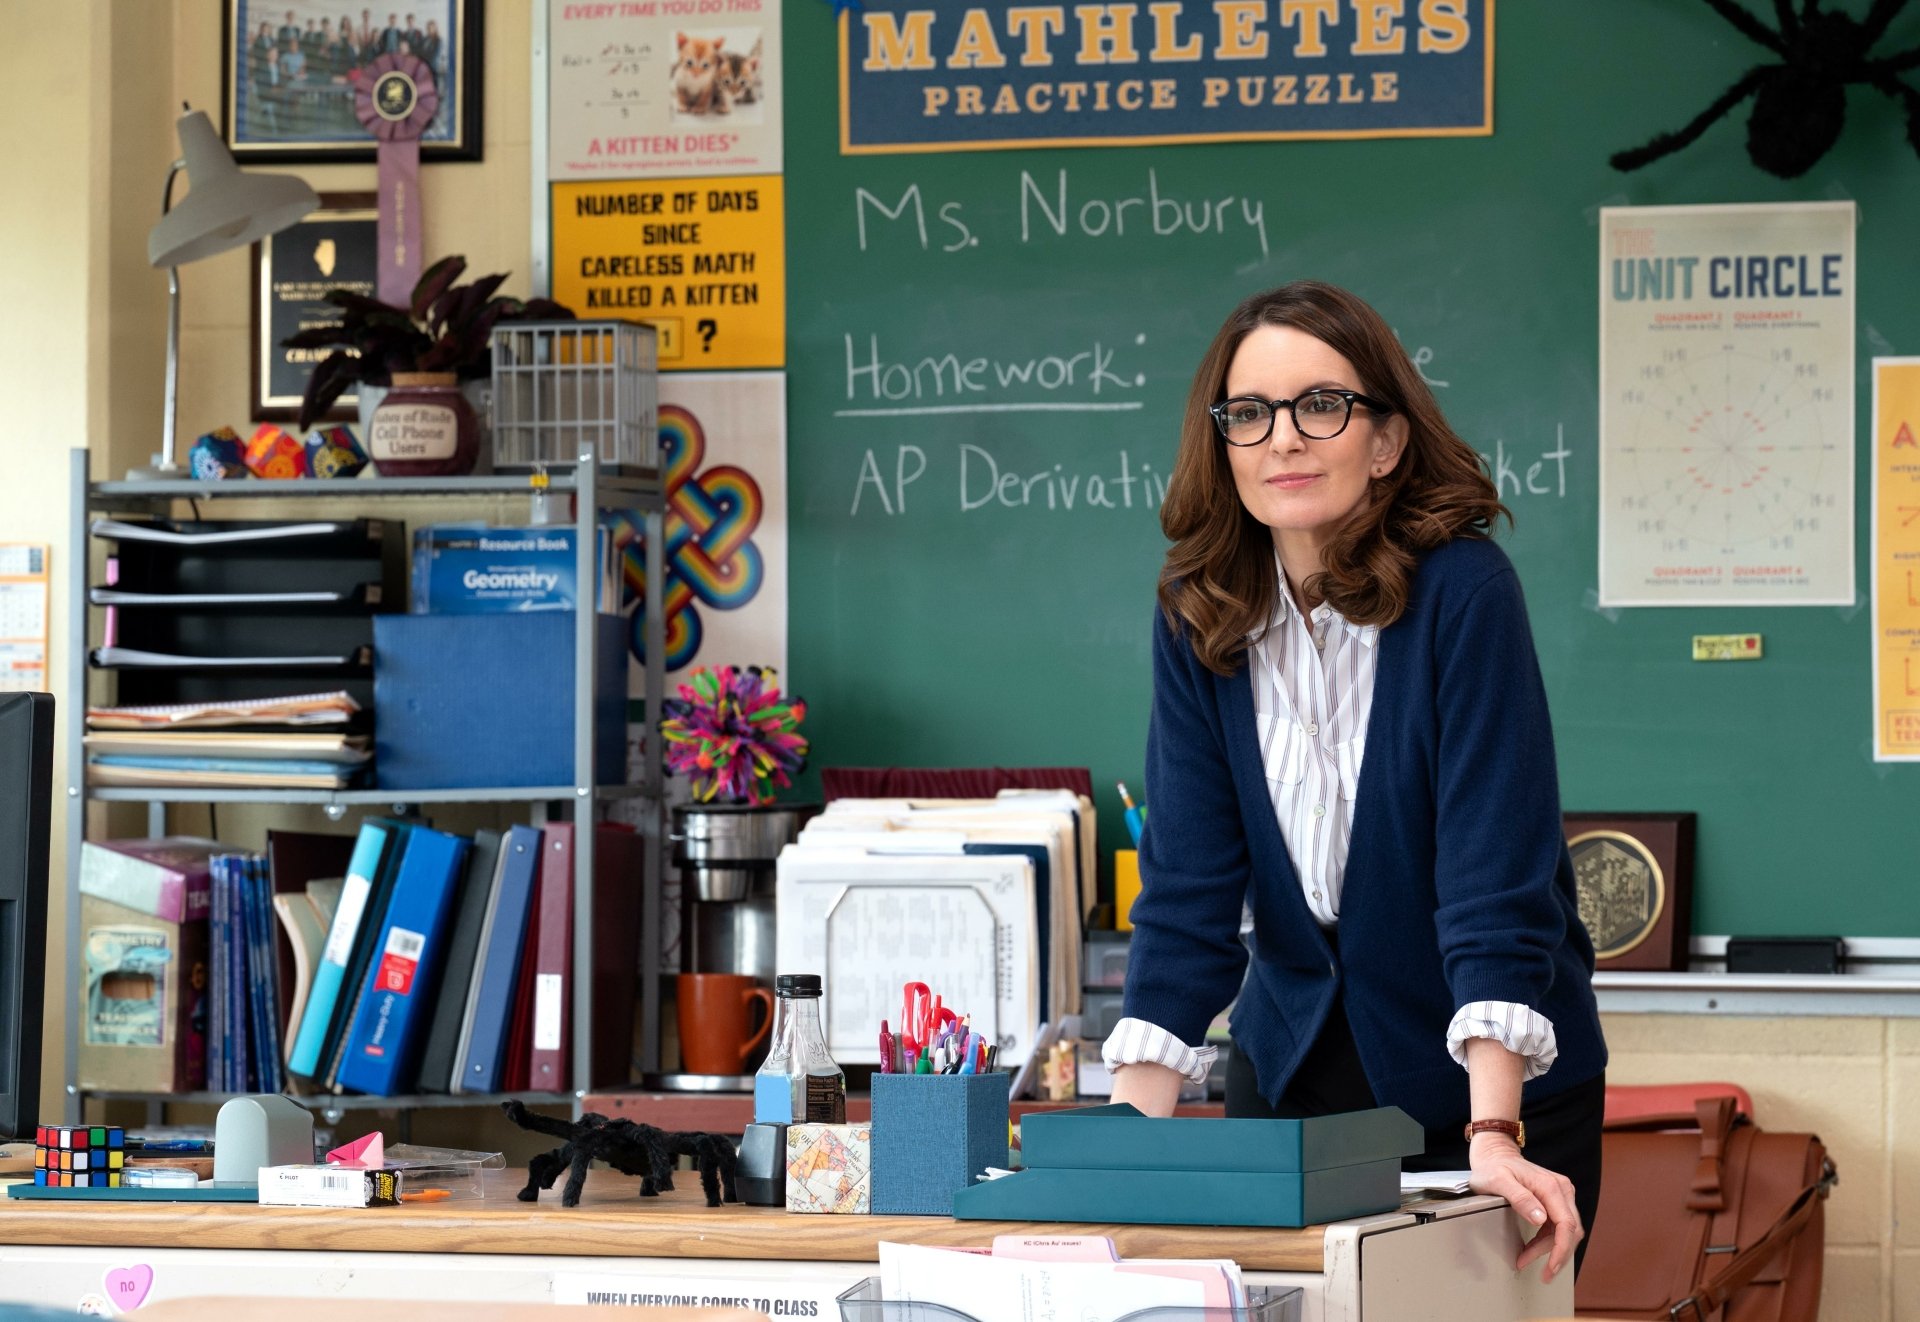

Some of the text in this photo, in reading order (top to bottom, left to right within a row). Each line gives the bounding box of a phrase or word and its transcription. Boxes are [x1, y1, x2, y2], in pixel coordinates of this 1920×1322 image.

[563, 0, 763, 20] EVERY TIME YOU DO THIS
[863, 0, 1472, 71] MATHLETES
[924, 73, 1400, 116] PRACTICE PUZZLE
[587, 138, 602, 156] A
[606, 137, 679, 156] KITTEN
[576, 190, 760, 217] NUMBER OF DAYS
[856, 168, 1269, 256] Ms. Norbury
[642, 223, 701, 246] SINCE
[1613, 228, 1656, 255] THE
[580, 252, 756, 278] CARELESS MATH
[1612, 254, 1843, 301] UNIT CIRCLE
[586, 283, 760, 309] KILLED A KITTEN
[1733, 311, 1794, 322] QUADRANT
[663, 319, 717, 353] 1 ?
[845, 333, 1148, 400] Homework:
[402, 425, 445, 440] Phone
[389, 440, 426, 456] Users
[851, 446, 926, 515] AP
[960, 443, 1173, 513] Derivativ
[479, 537, 536, 551] Resource
[537, 536, 569, 551] Book
[463, 569, 559, 592] Geometry
[120, 1281, 135, 1293] no
[587, 1292, 818, 1317] WHEN EVERYONE COMES TO CLASS
